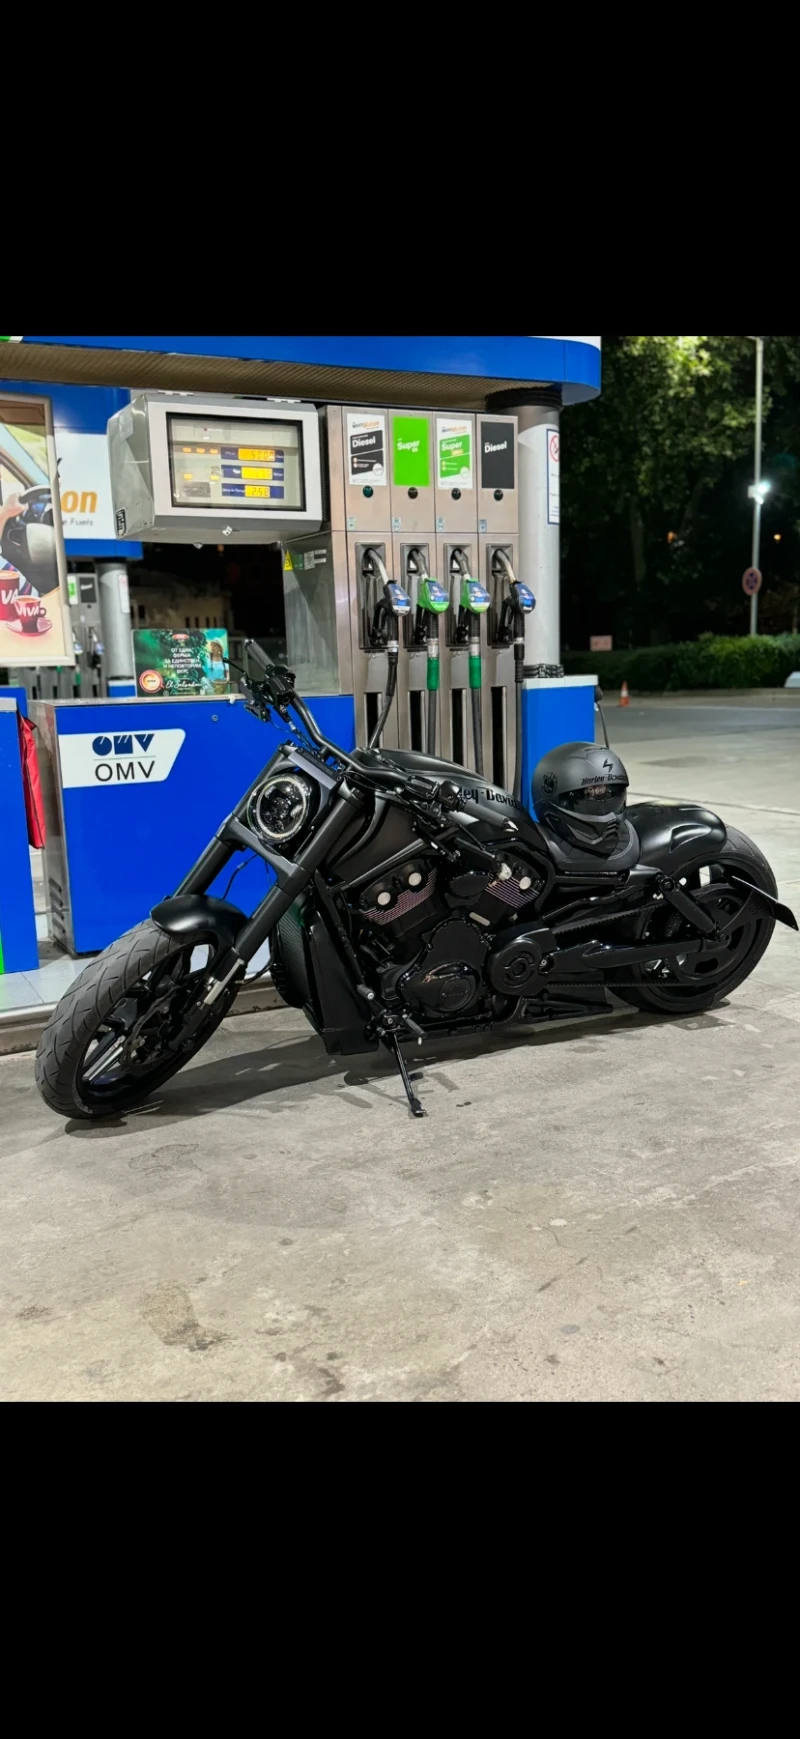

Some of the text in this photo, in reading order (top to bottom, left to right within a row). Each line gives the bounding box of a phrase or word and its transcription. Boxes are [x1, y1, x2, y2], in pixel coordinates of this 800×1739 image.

[352, 436, 376, 448] Diesel
[397, 440, 420, 450] Super
[441, 441, 463, 451] Super
[484, 441, 508, 453] Diesel
[70, 517, 94, 526] Fuels
[166, 680, 174, 689] El
[95, 760, 155, 782] OMV
